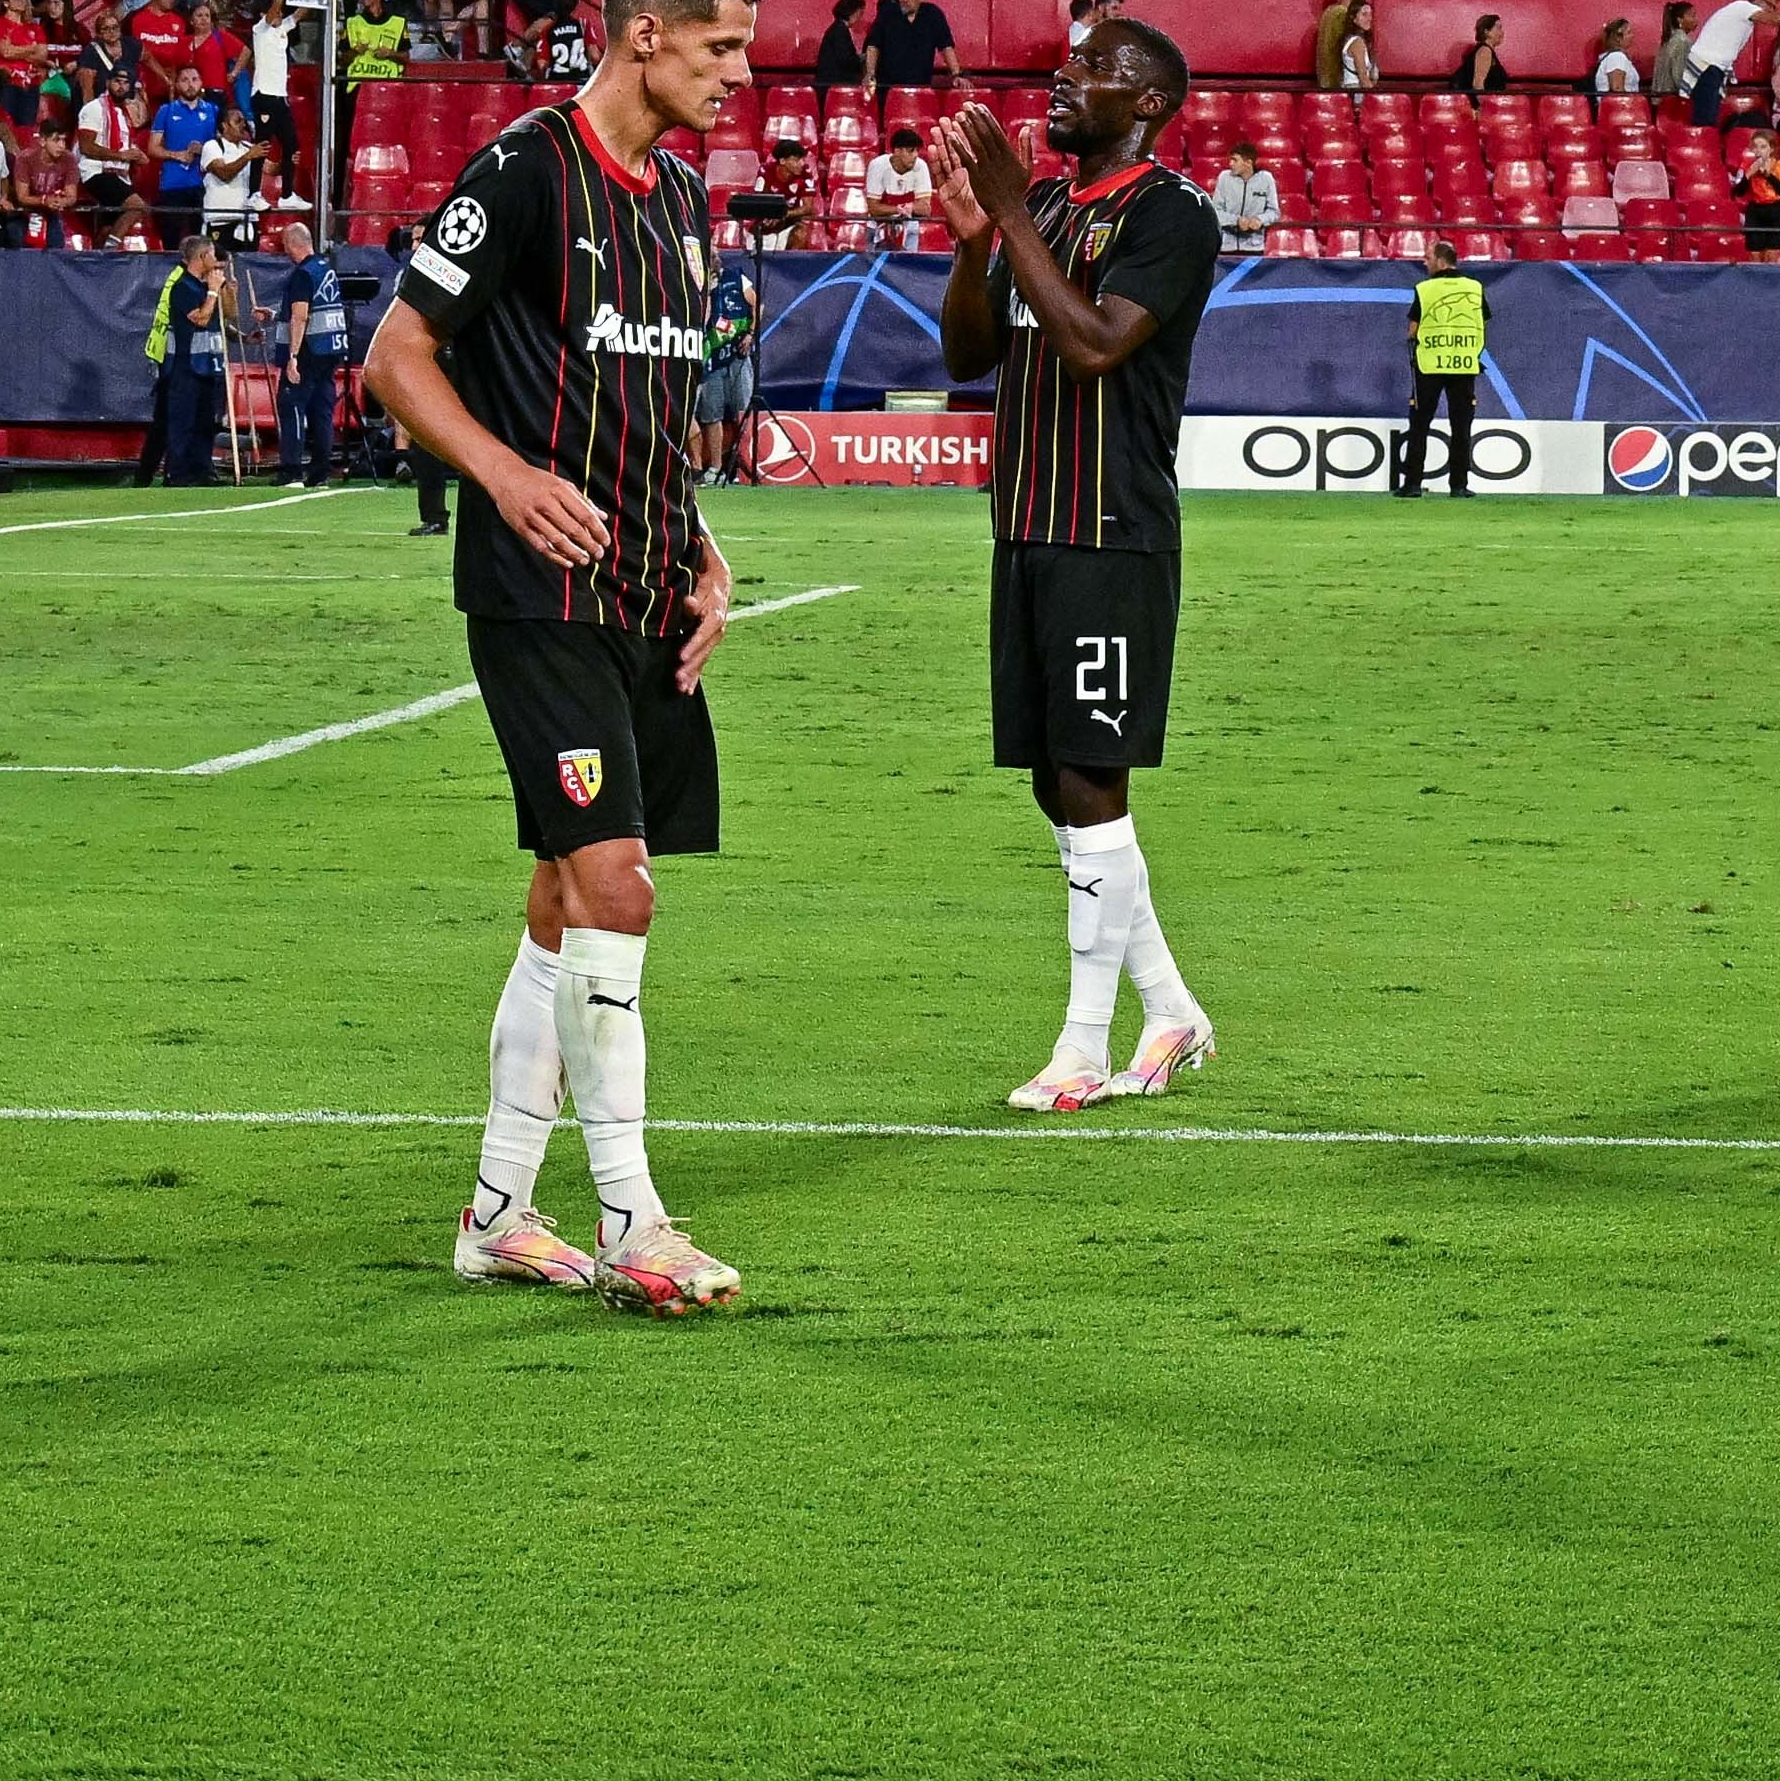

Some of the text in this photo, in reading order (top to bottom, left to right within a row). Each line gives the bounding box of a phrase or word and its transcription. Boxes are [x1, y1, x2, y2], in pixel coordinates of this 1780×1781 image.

[585, 303, 705, 361] Aucha
[1424, 335, 1478, 351] SECURIT
[1435, 355, 1474, 370] 1280
[831, 435, 989, 465] TURKISH
[1243, 425, 1532, 492] oppo
[1075, 636, 1128, 701] 21
[562, 764, 587, 802] RCL
